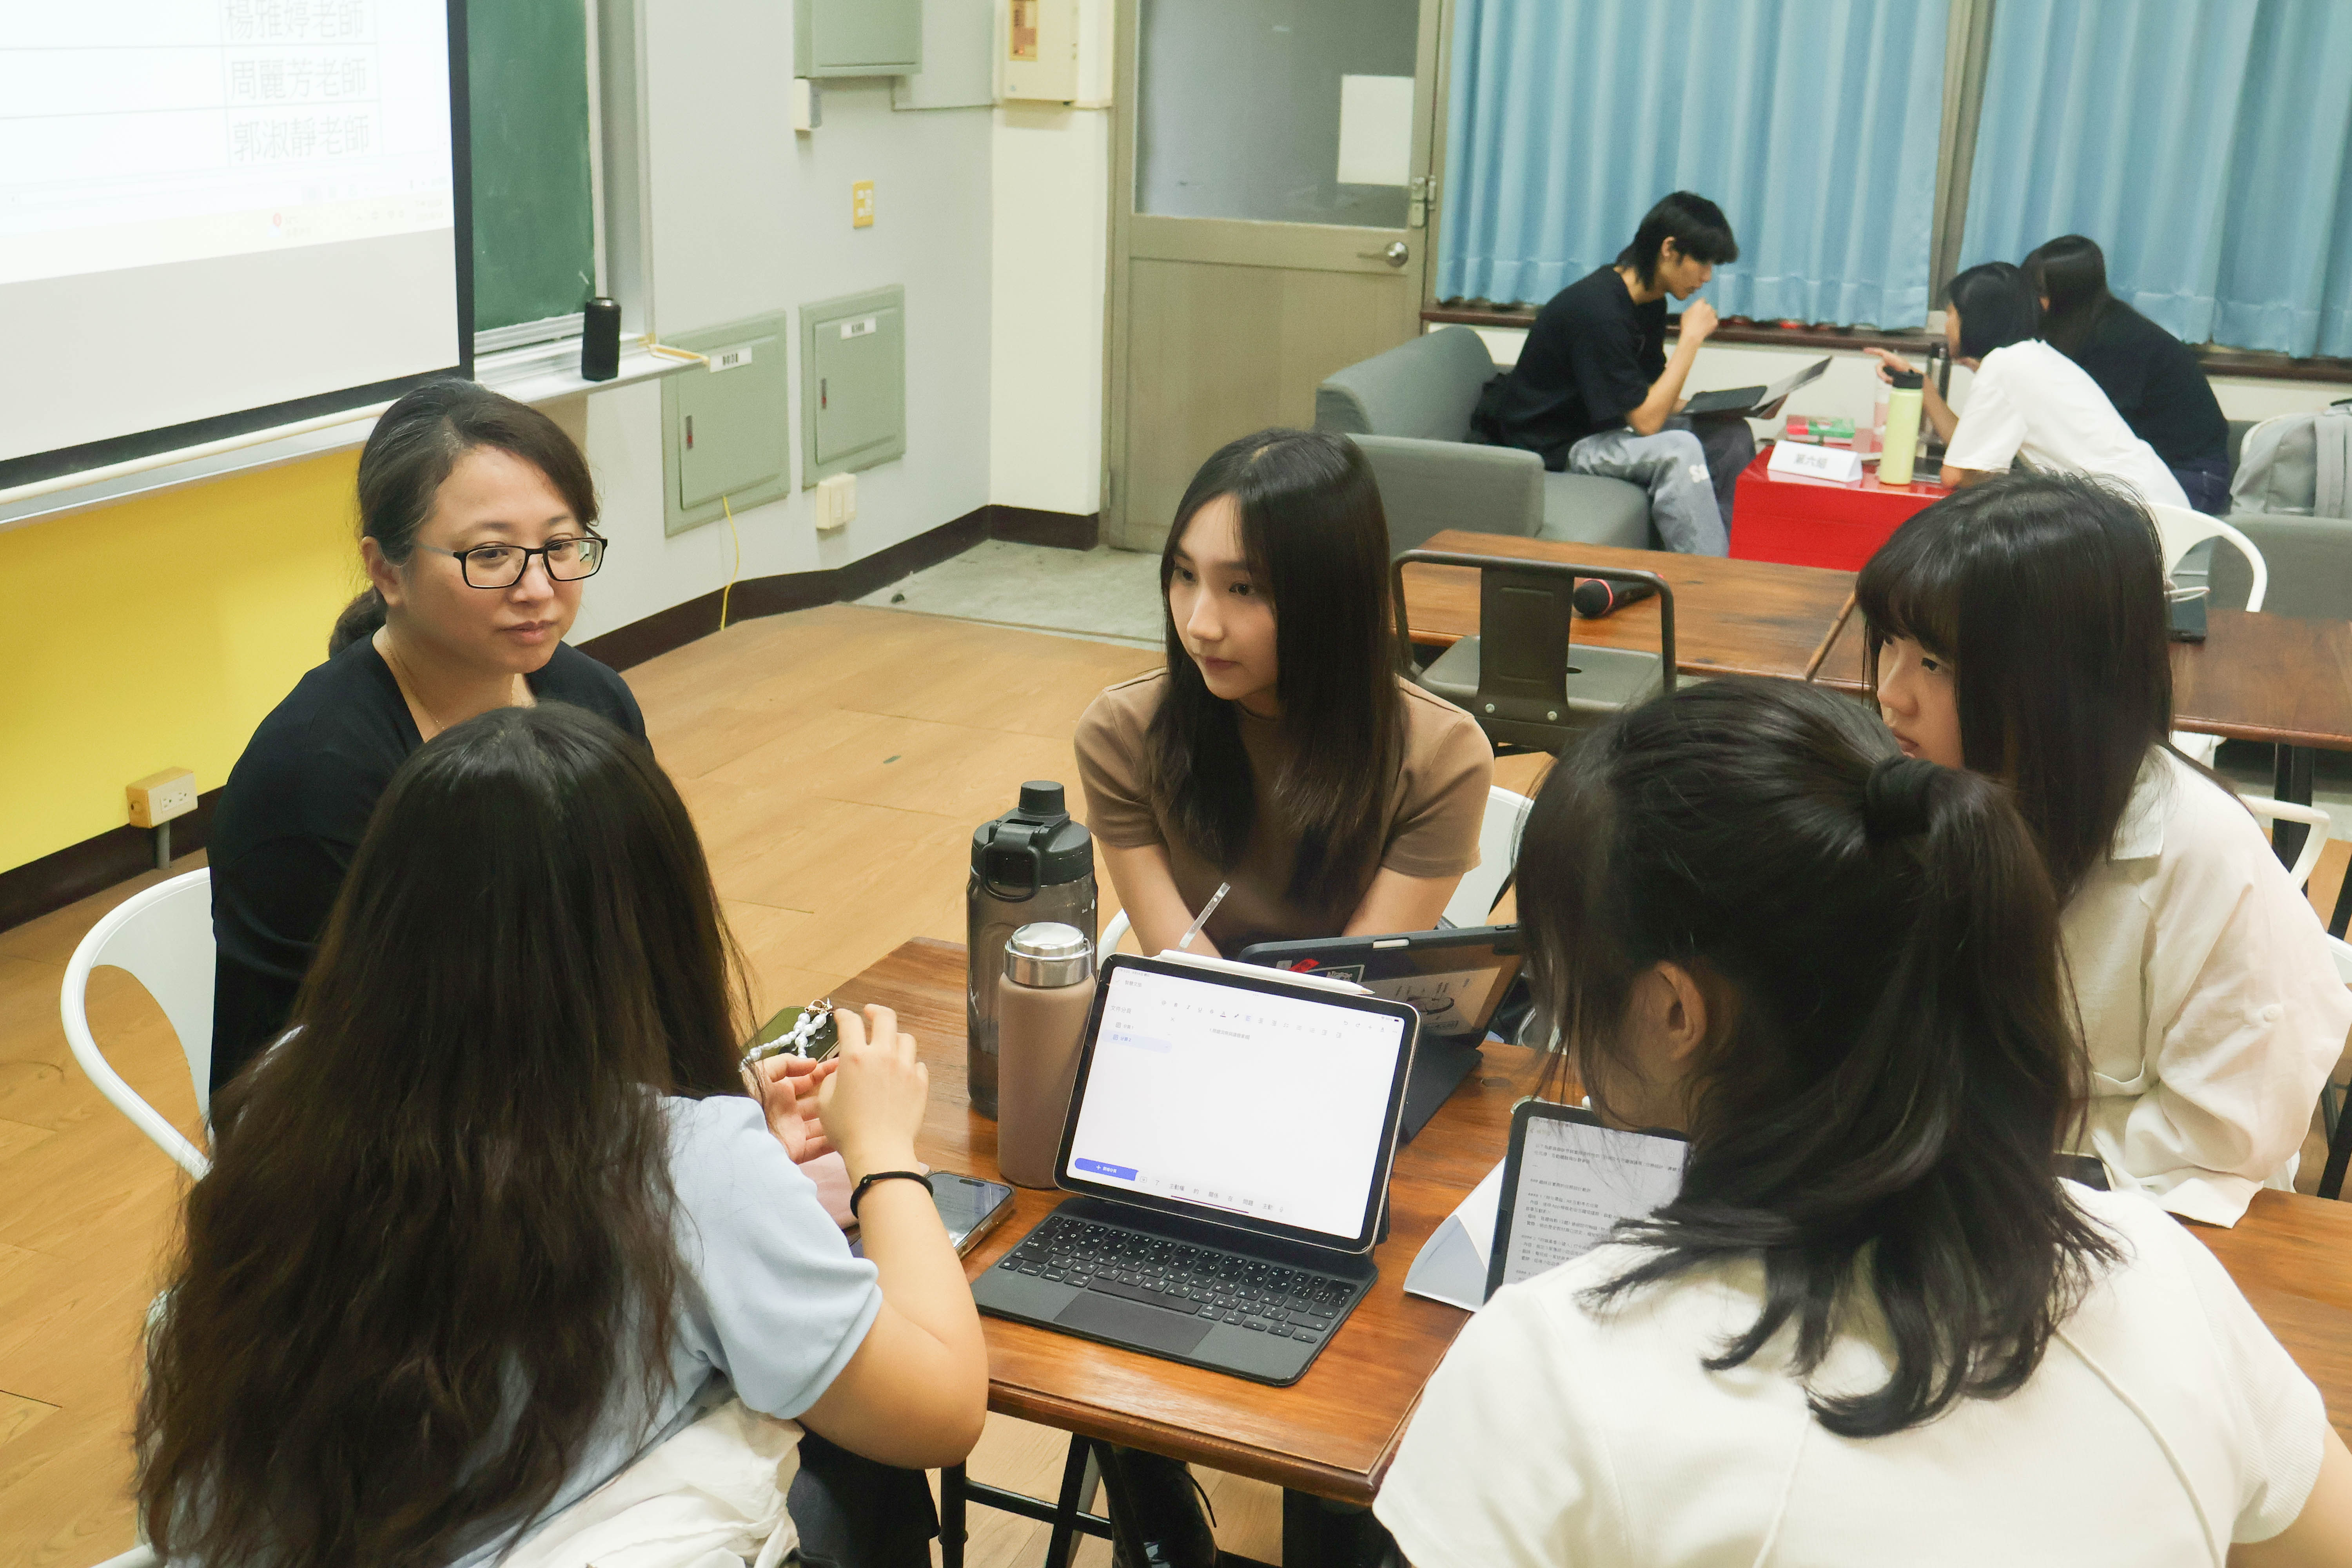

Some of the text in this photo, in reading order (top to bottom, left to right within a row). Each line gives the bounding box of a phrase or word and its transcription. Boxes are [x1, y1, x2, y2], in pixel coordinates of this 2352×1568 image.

[230, 57, 367, 101] 周麗芳老師
[232, 114, 369, 162] 郭淑靜老師
[1110, 1005, 1132, 1014] 文件分頁
